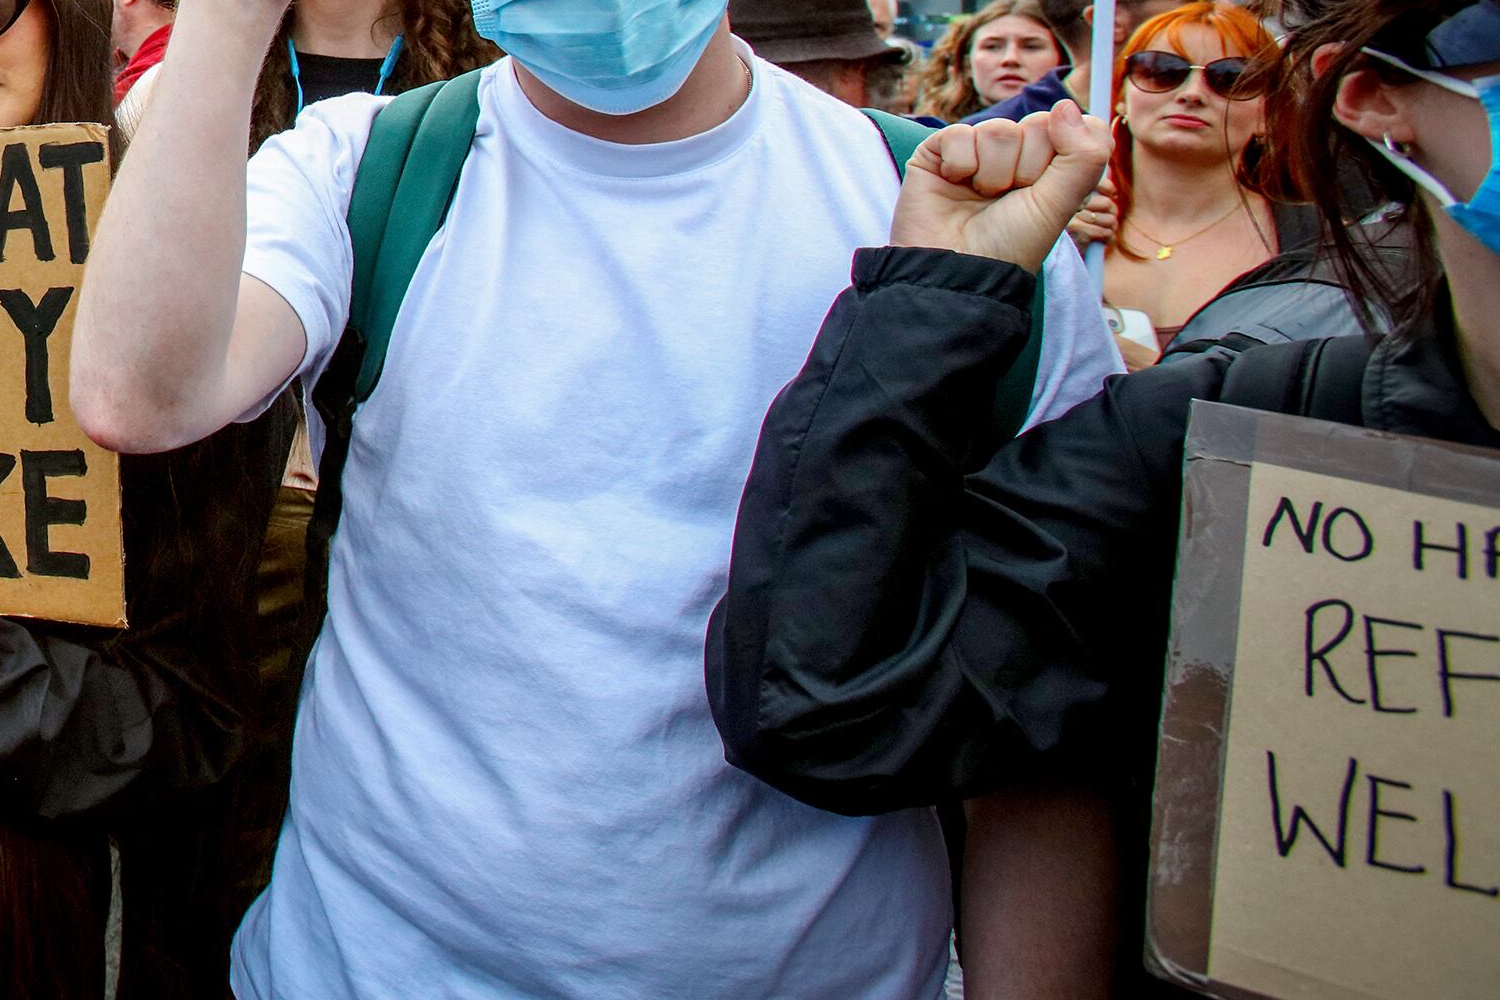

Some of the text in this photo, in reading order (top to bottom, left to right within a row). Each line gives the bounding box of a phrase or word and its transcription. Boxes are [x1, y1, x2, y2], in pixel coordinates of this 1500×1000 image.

[1262, 496, 1374, 562] NO
[1305, 599, 1500, 718] REF
[1266, 750, 1500, 897] WEL
